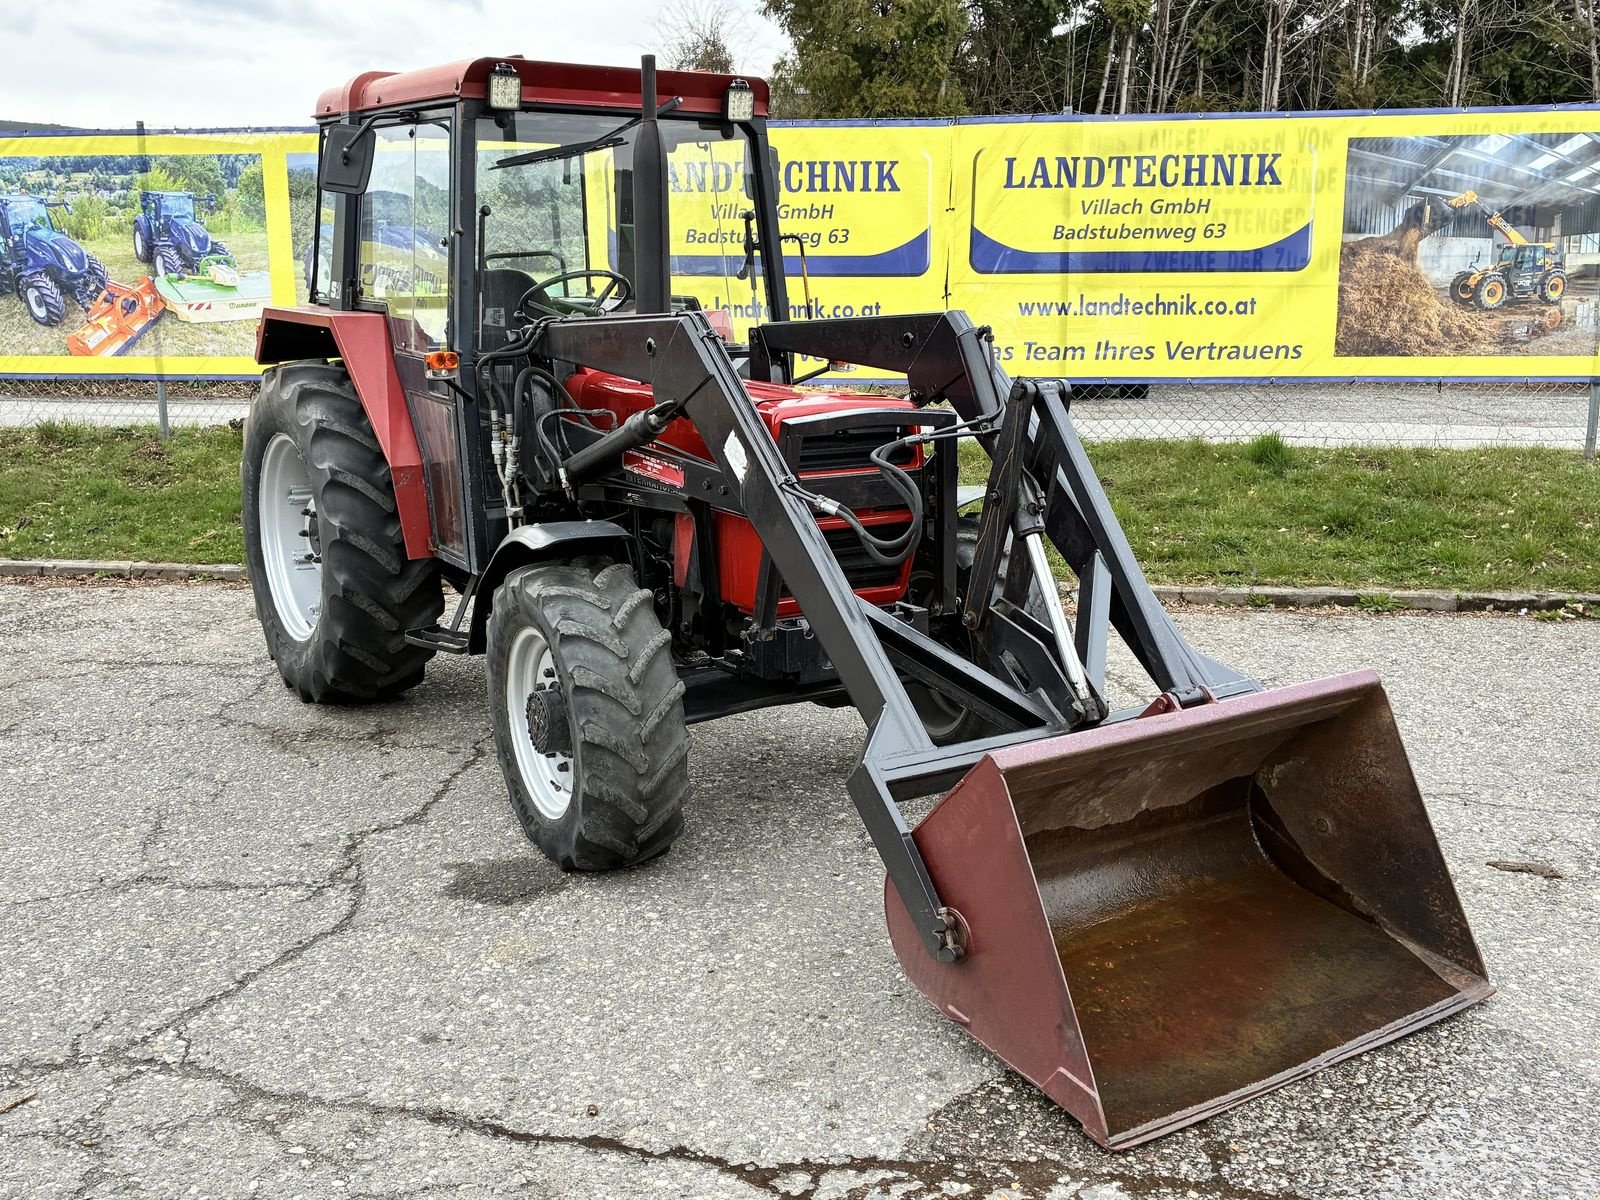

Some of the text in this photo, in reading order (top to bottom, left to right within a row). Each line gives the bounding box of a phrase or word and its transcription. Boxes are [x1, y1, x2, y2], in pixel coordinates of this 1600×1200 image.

[1003, 153, 1282, 189] LANDTECHNIK
[778, 203, 834, 220] GmbH
[1081, 198, 1211, 215] Villach GmbH
[828, 228, 850, 244] 63
[1052, 223, 1227, 243] Badstubenweg 63
[1018, 293, 1257, 317] www.landtechnik.co.at
[993, 339, 1303, 361] as Team Ihres Vertrauens
